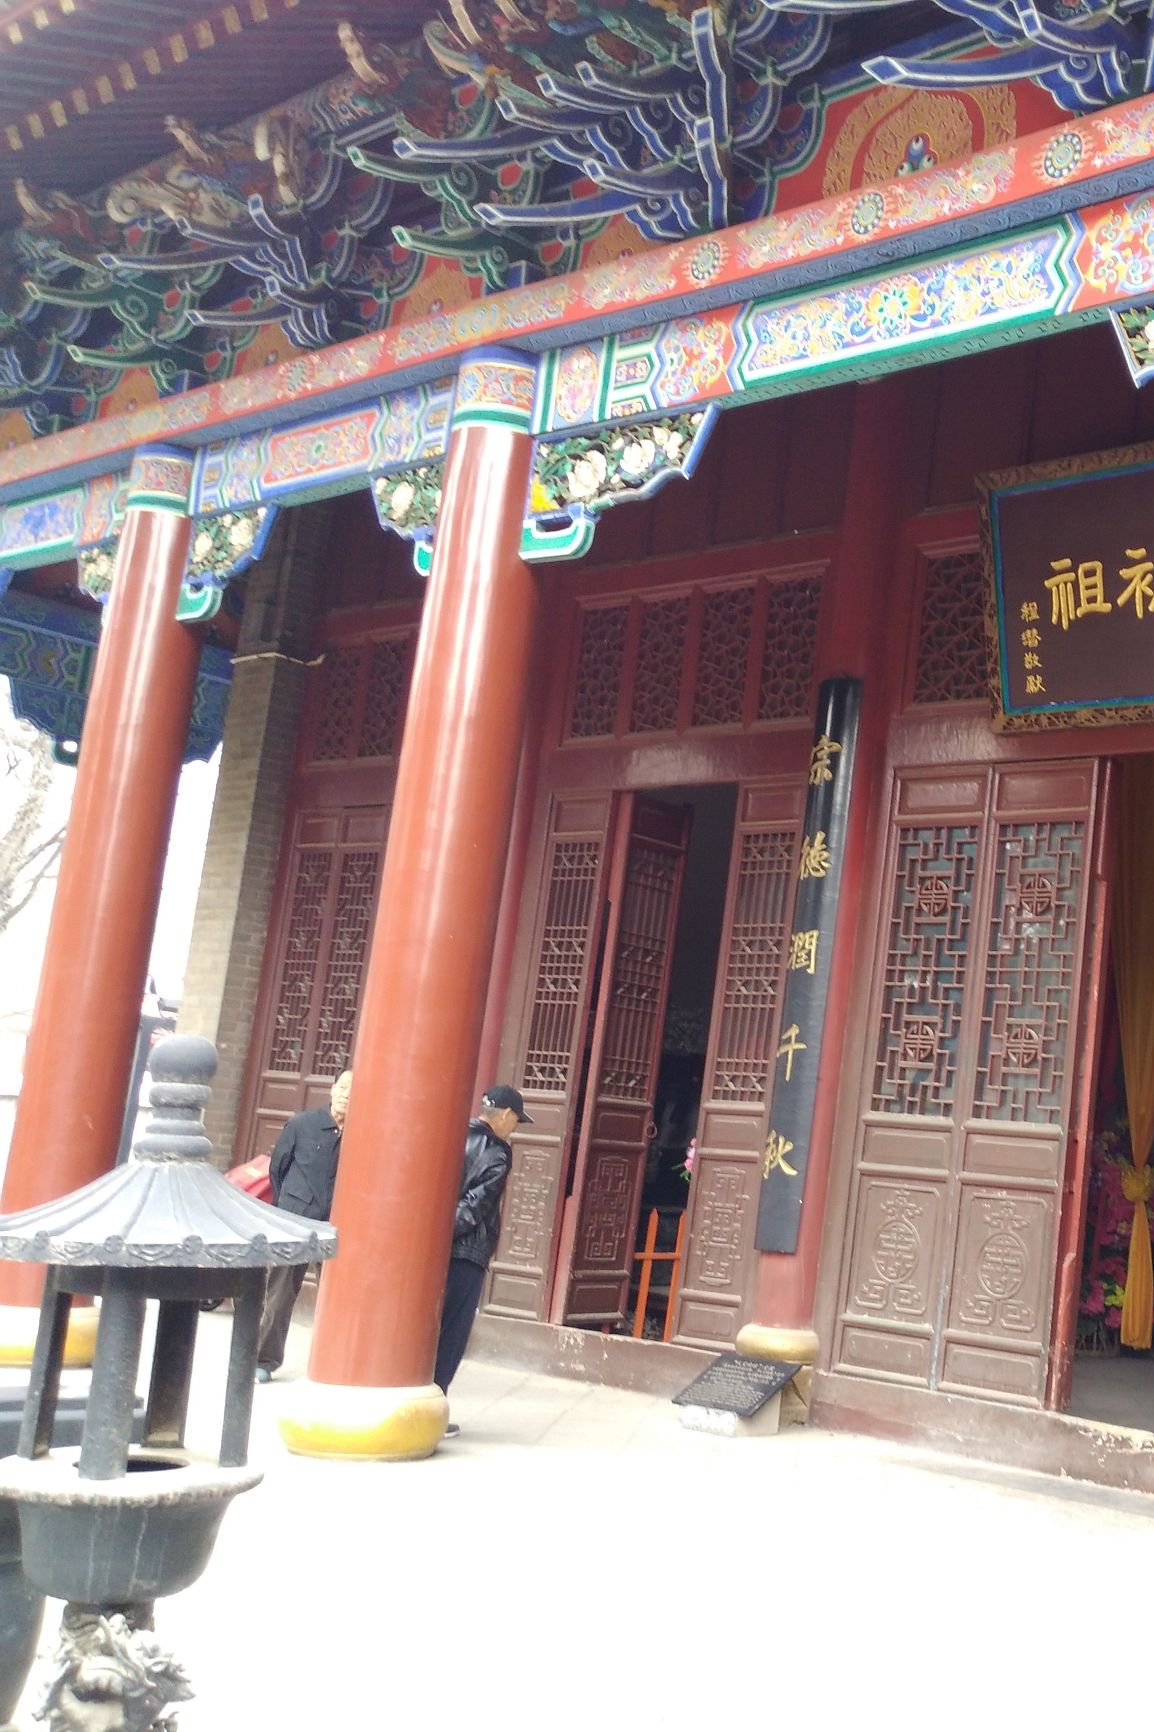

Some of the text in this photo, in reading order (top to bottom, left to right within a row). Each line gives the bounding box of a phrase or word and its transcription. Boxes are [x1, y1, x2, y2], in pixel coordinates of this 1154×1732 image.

[763, 734, 843, 1181] 宗德潤千秋
